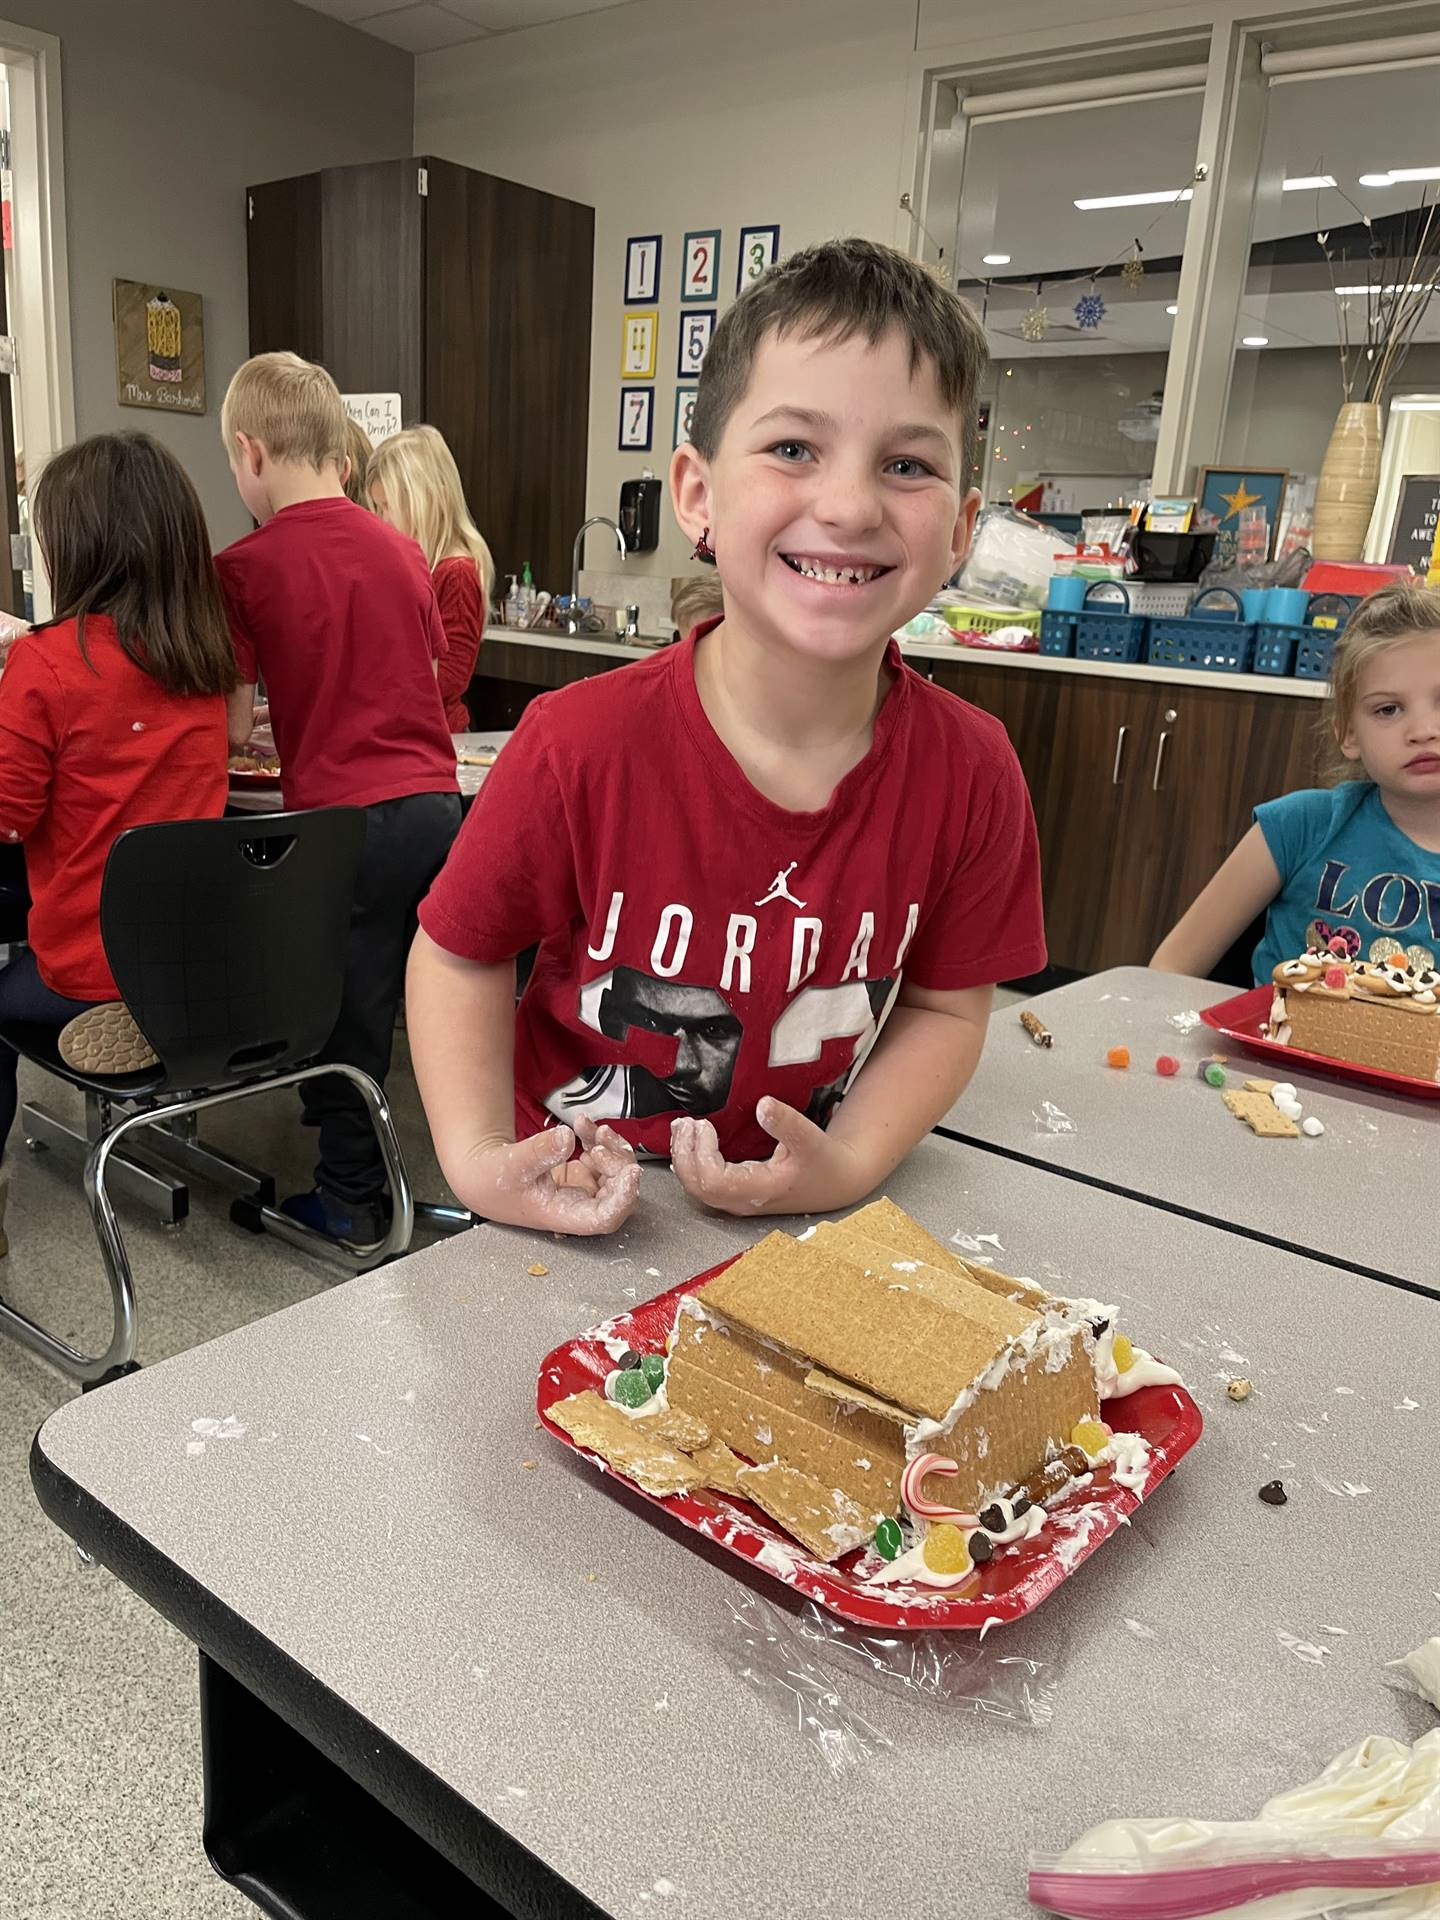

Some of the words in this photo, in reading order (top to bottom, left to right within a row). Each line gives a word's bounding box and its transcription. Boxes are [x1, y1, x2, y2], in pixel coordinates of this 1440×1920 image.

[640, 250, 646, 287] 1
[692, 247, 708, 284] 2
[748, 243, 765, 280] 3
[632, 325, 646, 363] 4
[688, 324, 704, 361] 5
[364, 400, 380, 418] Can
[384, 400, 393, 417] I
[367, 416, 398, 437] Drink?
[630, 399, 645, 435] 7
[683, 401, 695, 434] 8
